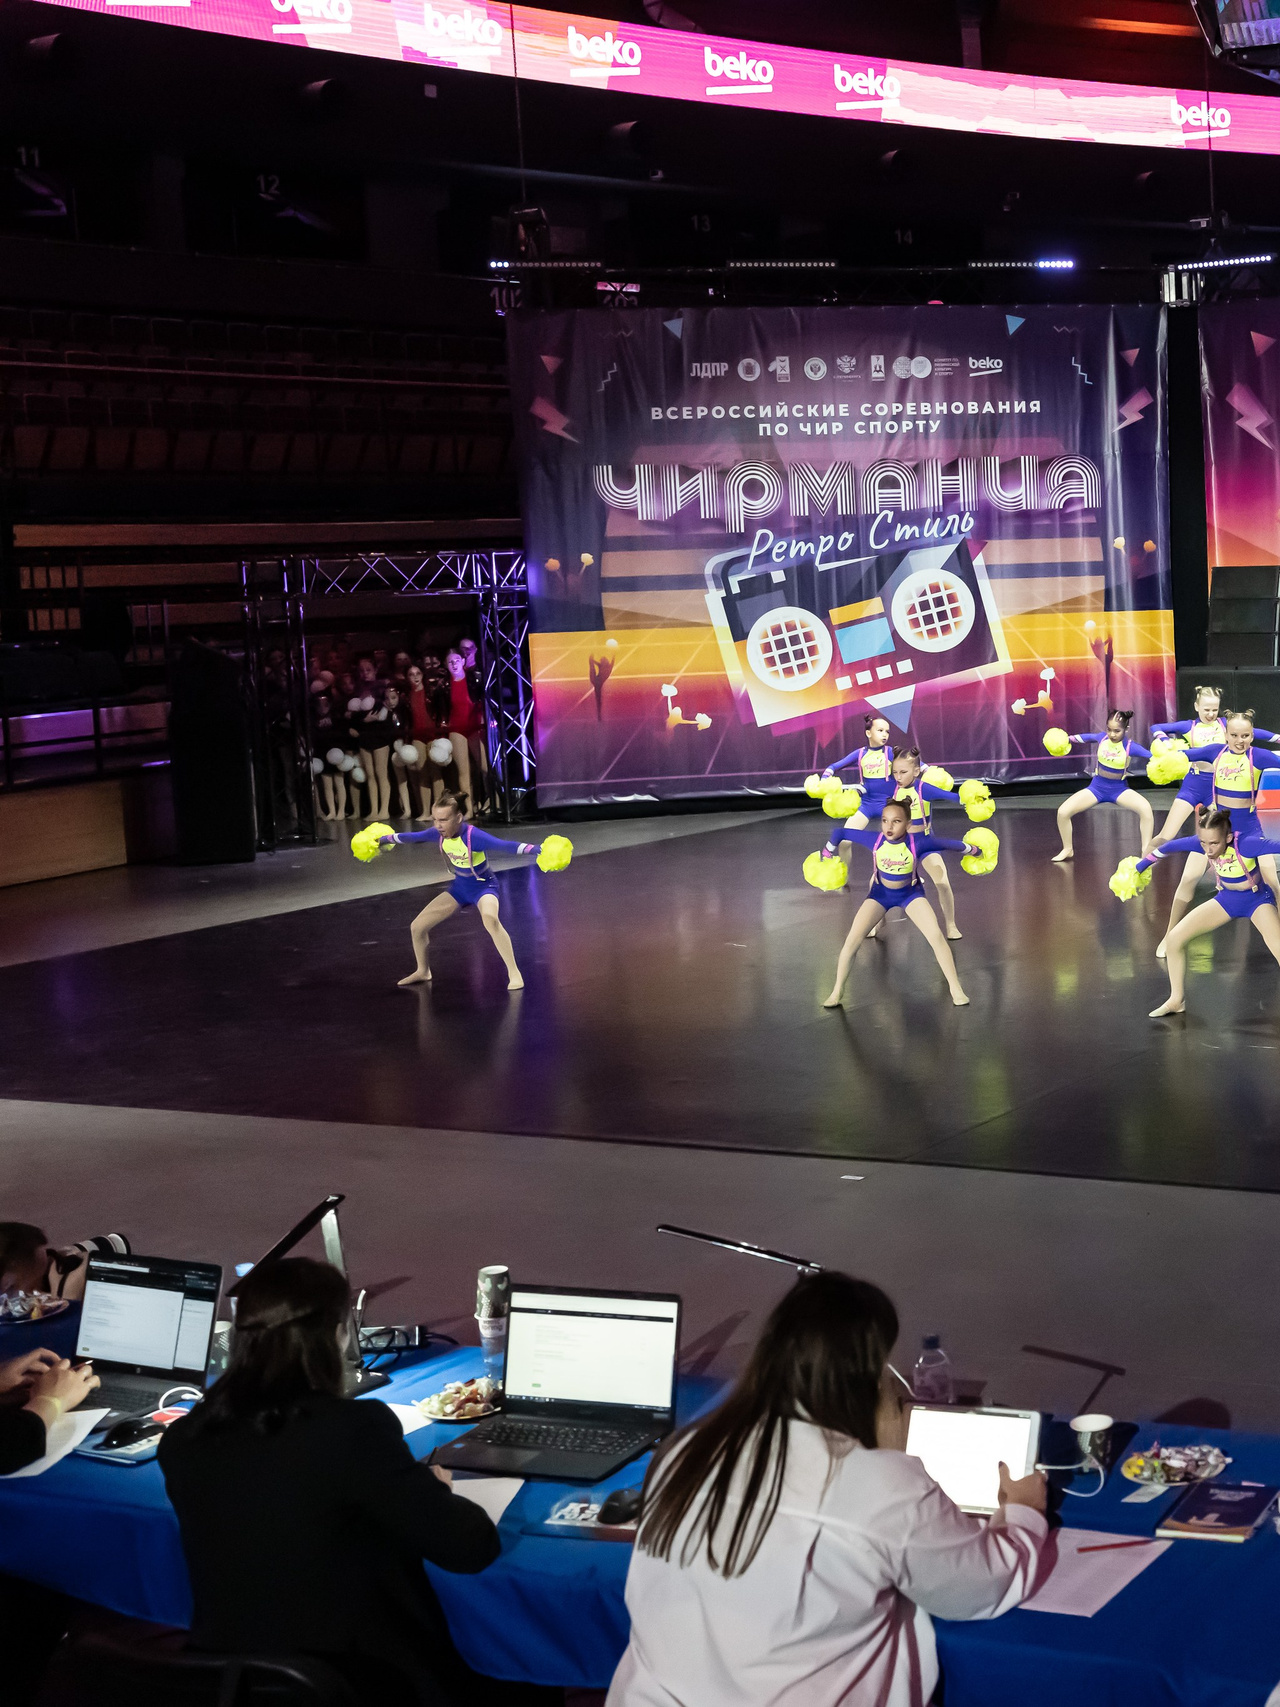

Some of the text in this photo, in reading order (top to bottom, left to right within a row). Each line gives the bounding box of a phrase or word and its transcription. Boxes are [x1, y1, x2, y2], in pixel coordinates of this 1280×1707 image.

[424, 2, 503, 45] beko
[567, 25, 642, 66] beko
[704, 46, 774, 84] beko
[833, 63, 901, 98] beko
[1170, 99, 1231, 128] beko
[17, 146, 40, 168] 11
[256, 174, 280, 194] 12
[690, 214, 712, 232] 13
[894, 228, 913, 245] 14
[690, 362, 729, 379] ЛДПР
[968, 356, 1003, 370] beko
[651, 400, 1041, 420] ВСЕРОССИЙСКИЕ СОРЕВНОВАНИЯ
[758, 420, 941, 437] ПО ЧИР СПОРТУ
[747, 509, 975, 571] Ретро Стиль
